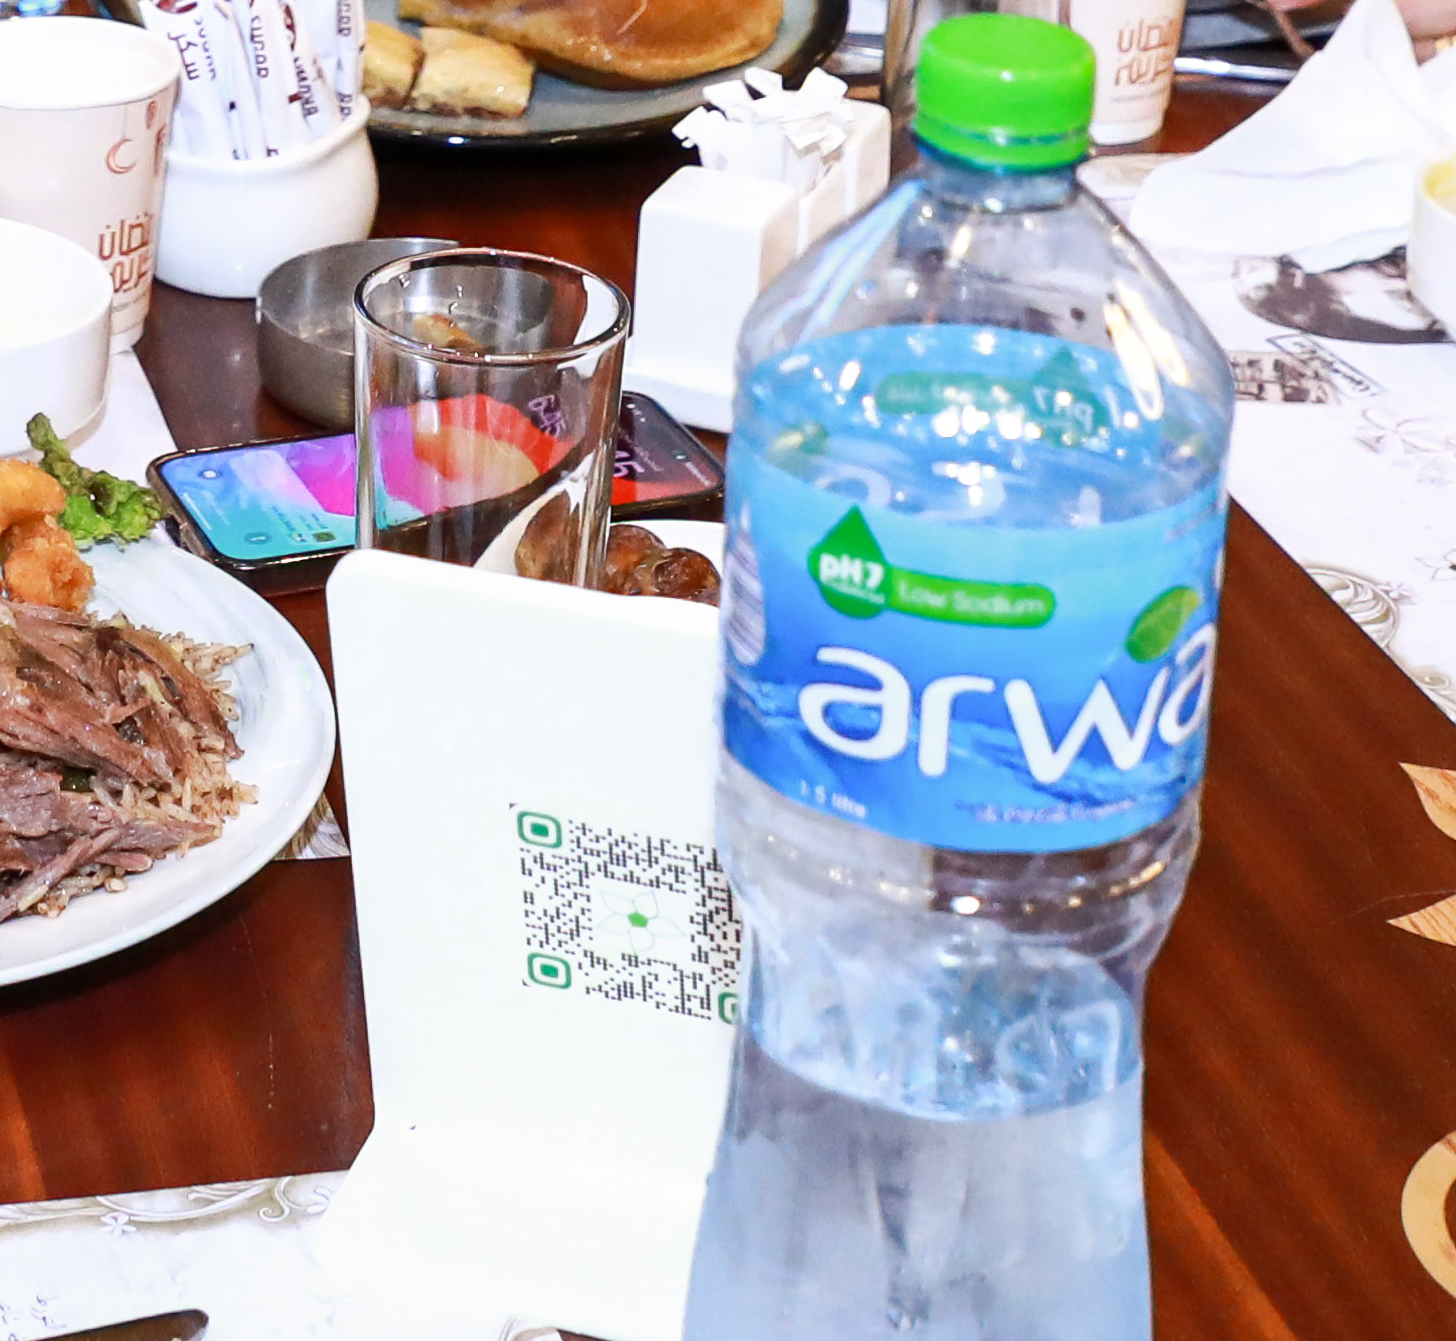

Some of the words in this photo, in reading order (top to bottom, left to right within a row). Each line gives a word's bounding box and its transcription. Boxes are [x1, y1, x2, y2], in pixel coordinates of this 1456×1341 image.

[899, 581, 947, 609] Low
[951, 589, 1045, 615] Sodium
[798, 623, 1219, 784] arwa
